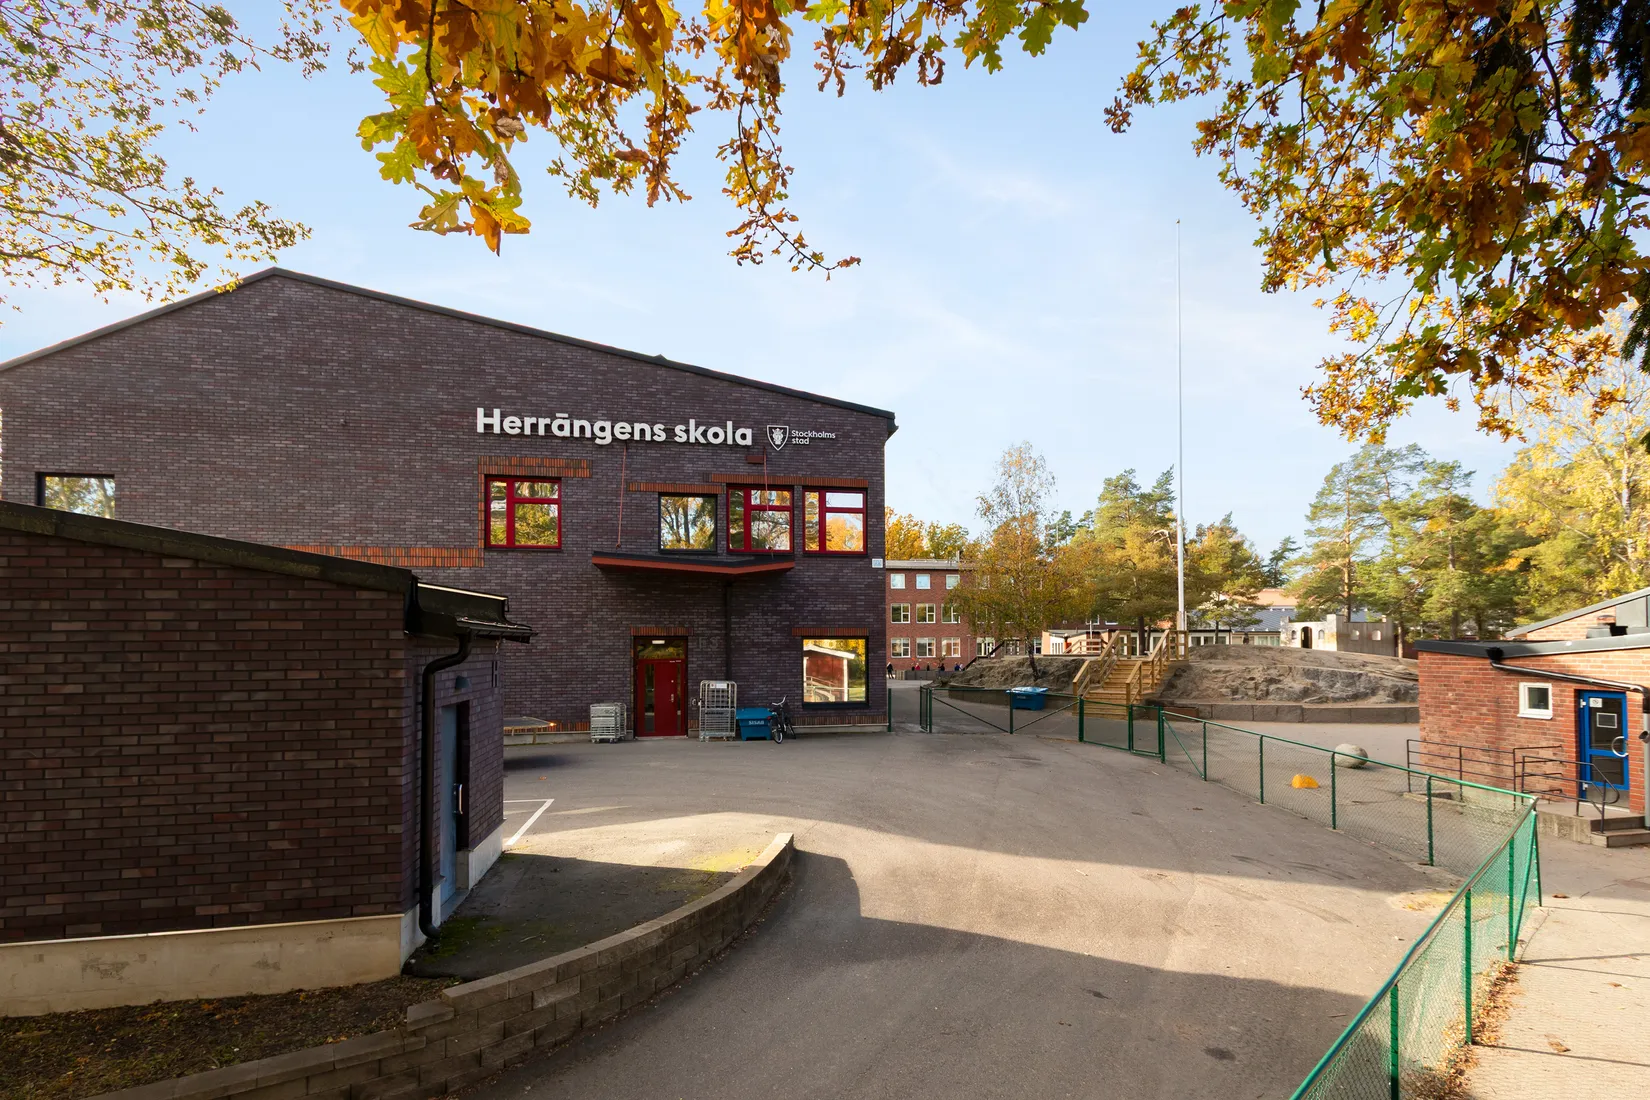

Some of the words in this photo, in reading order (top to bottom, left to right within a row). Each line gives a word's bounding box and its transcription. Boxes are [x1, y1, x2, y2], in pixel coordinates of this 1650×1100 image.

[674, 418, 752, 446] skola
[791, 429, 836, 439] Stockholms
[791, 437, 810, 445] stad
